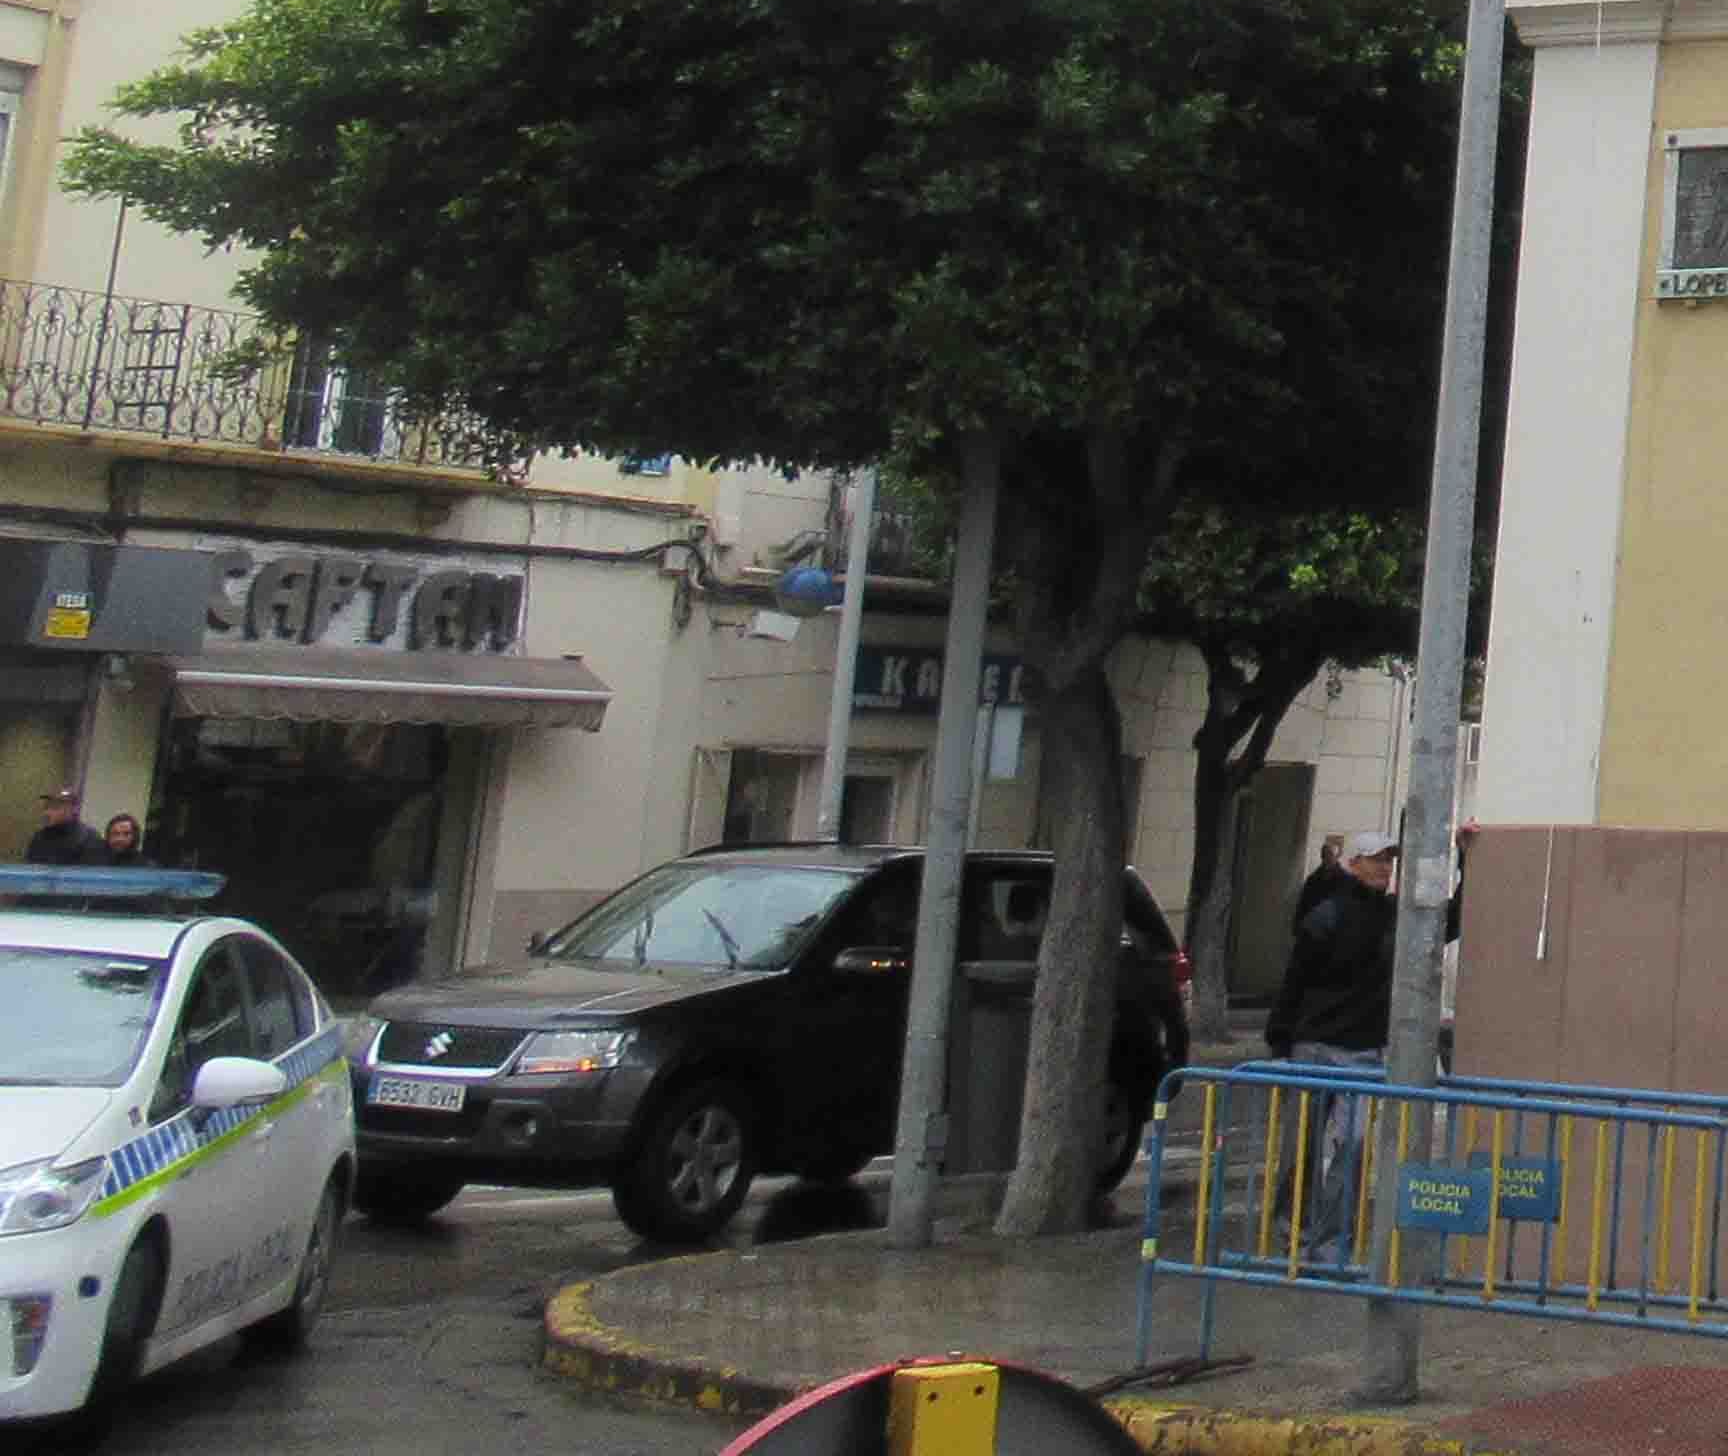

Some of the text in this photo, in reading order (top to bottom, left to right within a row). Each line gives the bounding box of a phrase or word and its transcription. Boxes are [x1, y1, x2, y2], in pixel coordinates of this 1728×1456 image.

[1672, 272, 1728, 294] LOPE
[1408, 1179, 1472, 1199] POLICIA
[1411, 1197, 1464, 1215] LOCAL
